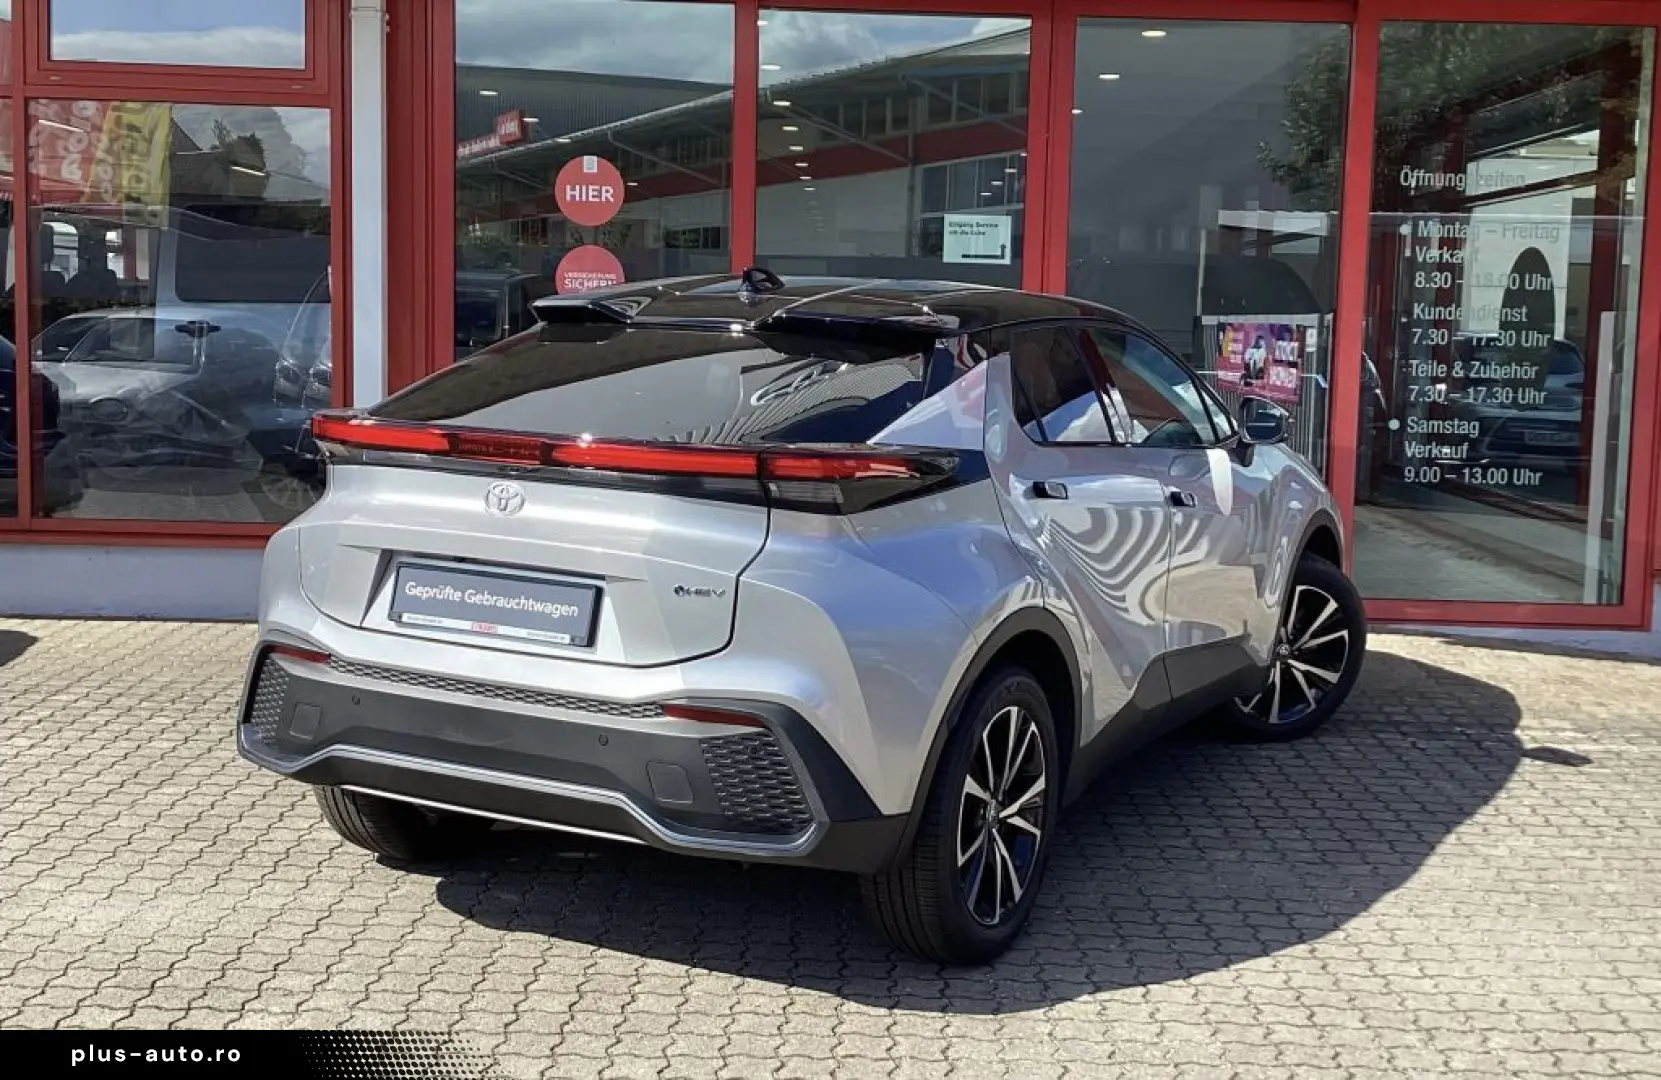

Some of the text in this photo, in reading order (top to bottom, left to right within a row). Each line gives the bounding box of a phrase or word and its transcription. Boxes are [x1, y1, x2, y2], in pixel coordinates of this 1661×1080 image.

[1400, 165, 1526, 191] Öffnungzeiten
[565, 184, 614, 203] HIER
[1502, 222, 1561, 243] Freitag
[1415, 271, 1452, 289] 8.30
[1525, 273, 1553, 291] Uhr
[1413, 302, 1528, 322] Kundendienst
[1411, 328, 1448, 346] 7.30
[1472, 330, 1516, 347] 17.30
[1522, 330, 1551, 347] Uhr
[1410, 359, 1539, 379] Teile & Zubehör
[1408, 385, 1446, 402] 7.30
[1466, 386, 1513, 404] 17.30
[1518, 387, 1548, 405] Uhr
[1407, 416, 1480, 438] Samstag
[1404, 441, 1469, 459] Verkauf
[1404, 466, 1441, 483] 9.00
[1462, 466, 1508, 485] 13.00
[1513, 467, 1544, 486] Uhr
[405, 581, 578, 618] Geprüfte Gebrauchtwagen
